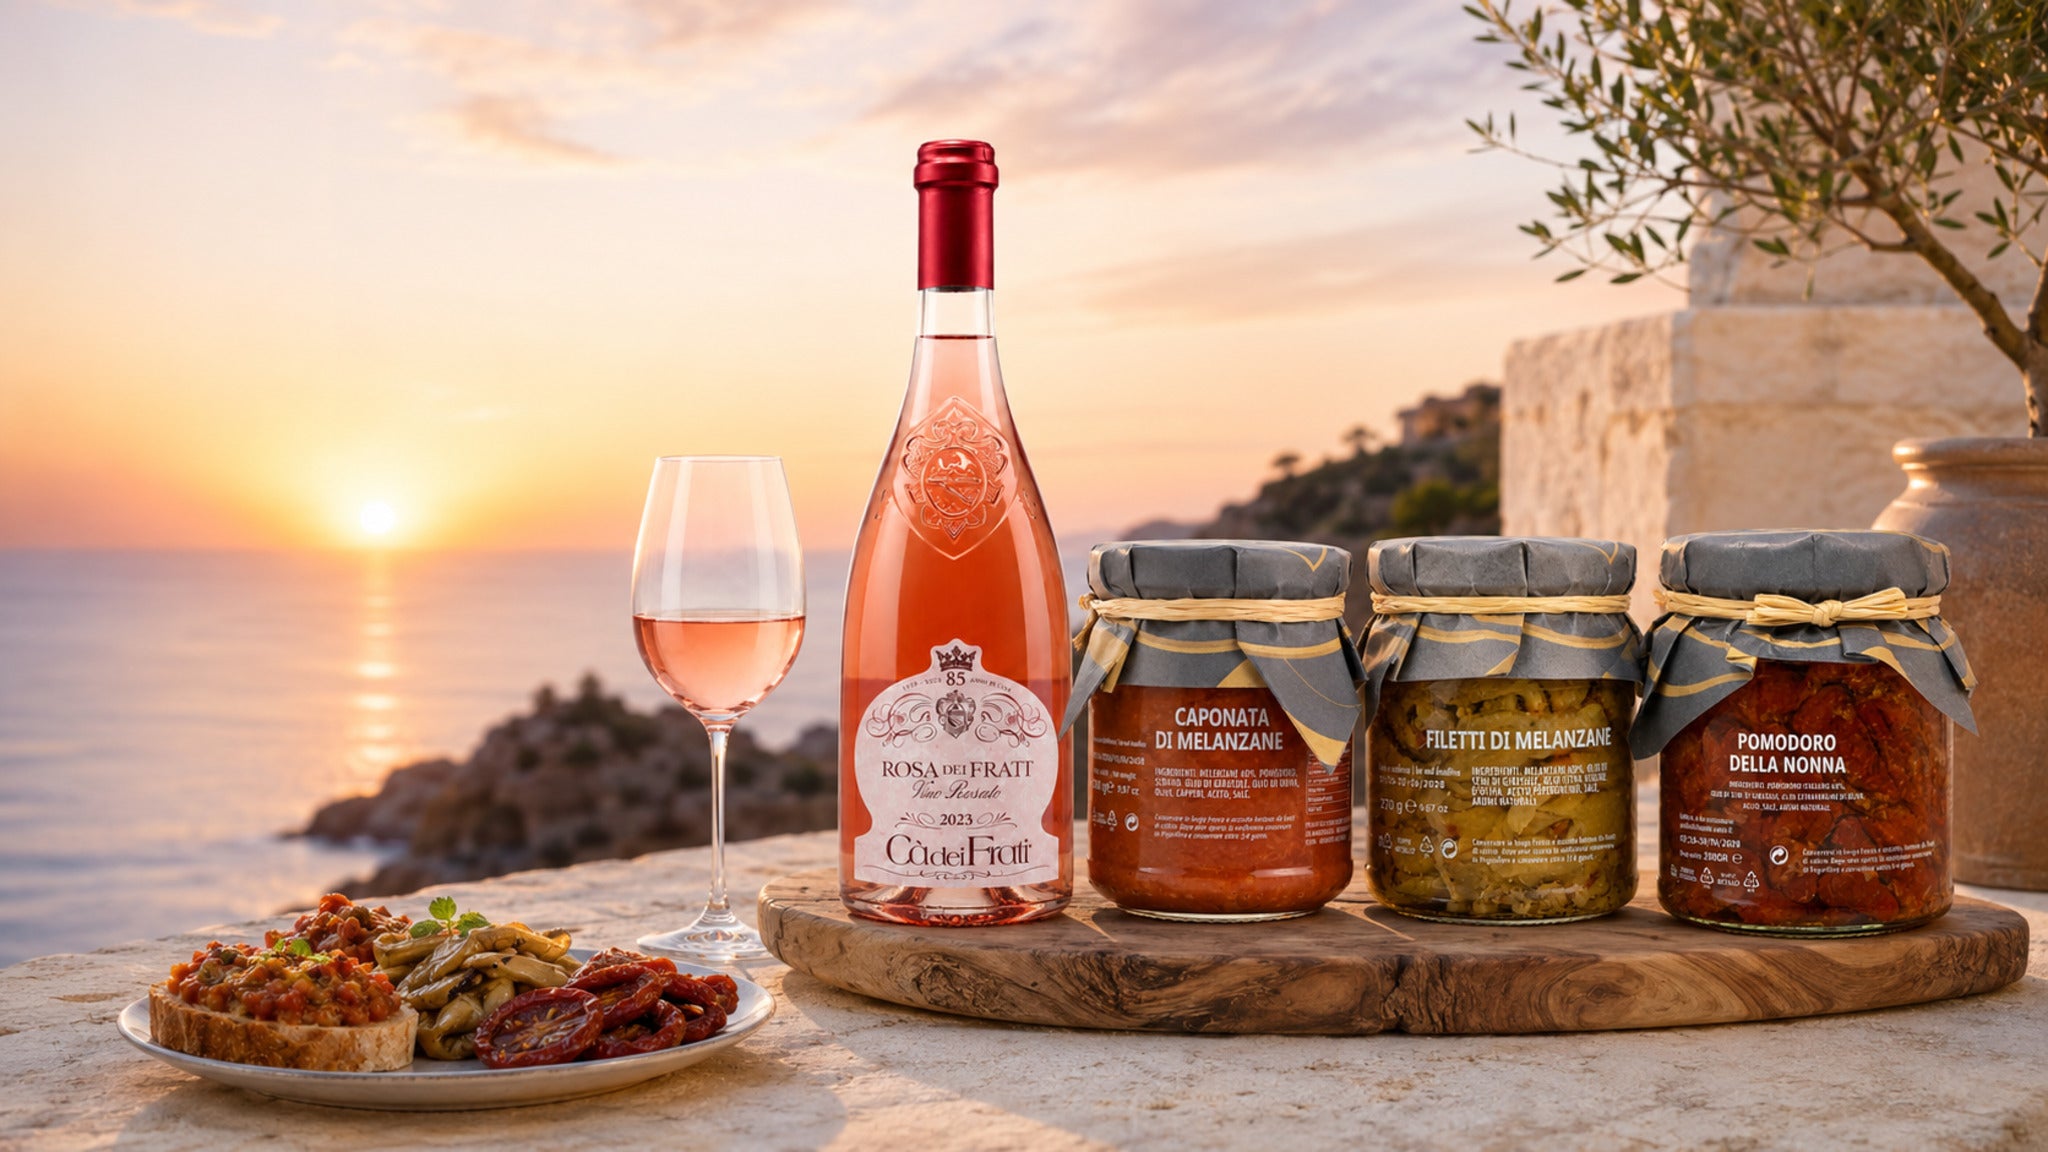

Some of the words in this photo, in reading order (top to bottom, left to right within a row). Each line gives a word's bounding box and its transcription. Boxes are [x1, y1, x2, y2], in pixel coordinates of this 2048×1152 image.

[946, 671, 966, 686] 85
[1175, 707, 1270, 727] CAPONATA
[1155, 731, 1173, 749] DI
[1177, 732, 1283, 750] MELANZANE
[1426, 729, 1485, 749] FILETTI
[1490, 731, 1511, 750] DI
[1515, 727, 1612, 750] MELANZANE
[1738, 732, 1836, 751] POMODORO
[882, 761, 939, 778] ROSA
[943, 764, 967, 776] DEI
[970, 760, 1034, 778] FRATI
[1730, 754, 1779, 773] DELLA
[1783, 756, 1846, 774] NONNA
[940, 813, 974, 826] 2023
